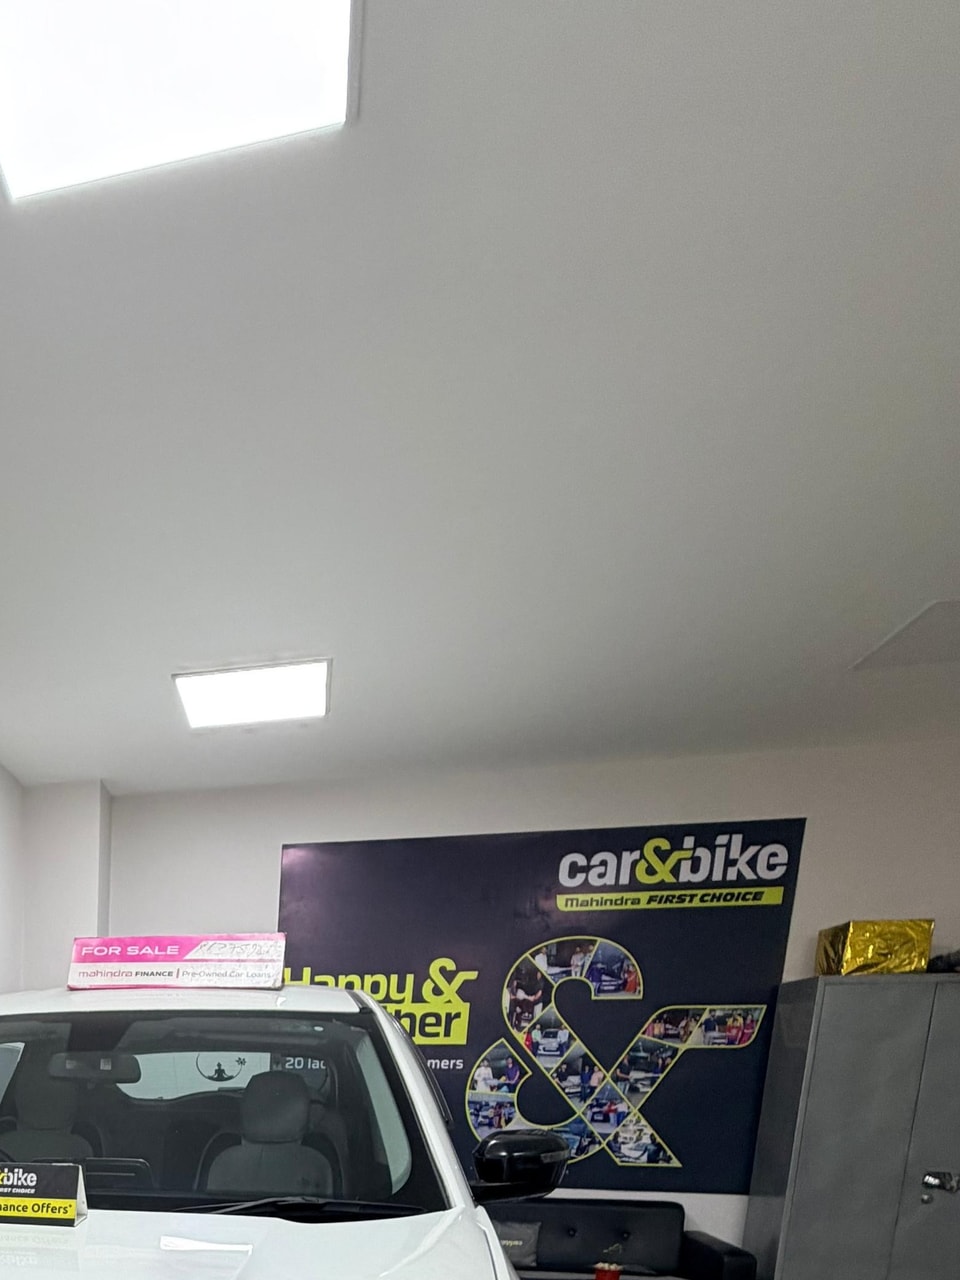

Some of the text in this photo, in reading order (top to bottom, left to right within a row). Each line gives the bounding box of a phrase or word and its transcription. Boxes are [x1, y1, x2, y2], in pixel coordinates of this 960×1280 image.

[558, 833, 789, 888] car&bike
[646, 892, 695, 905] FIRST
[699, 891, 765, 903] CHOICE
[81, 945, 179, 956] FOR SALE
[135, 970, 174, 978] FINANCE
[229, 970, 243, 978] Car
[285, 1057, 304, 1069] 20
